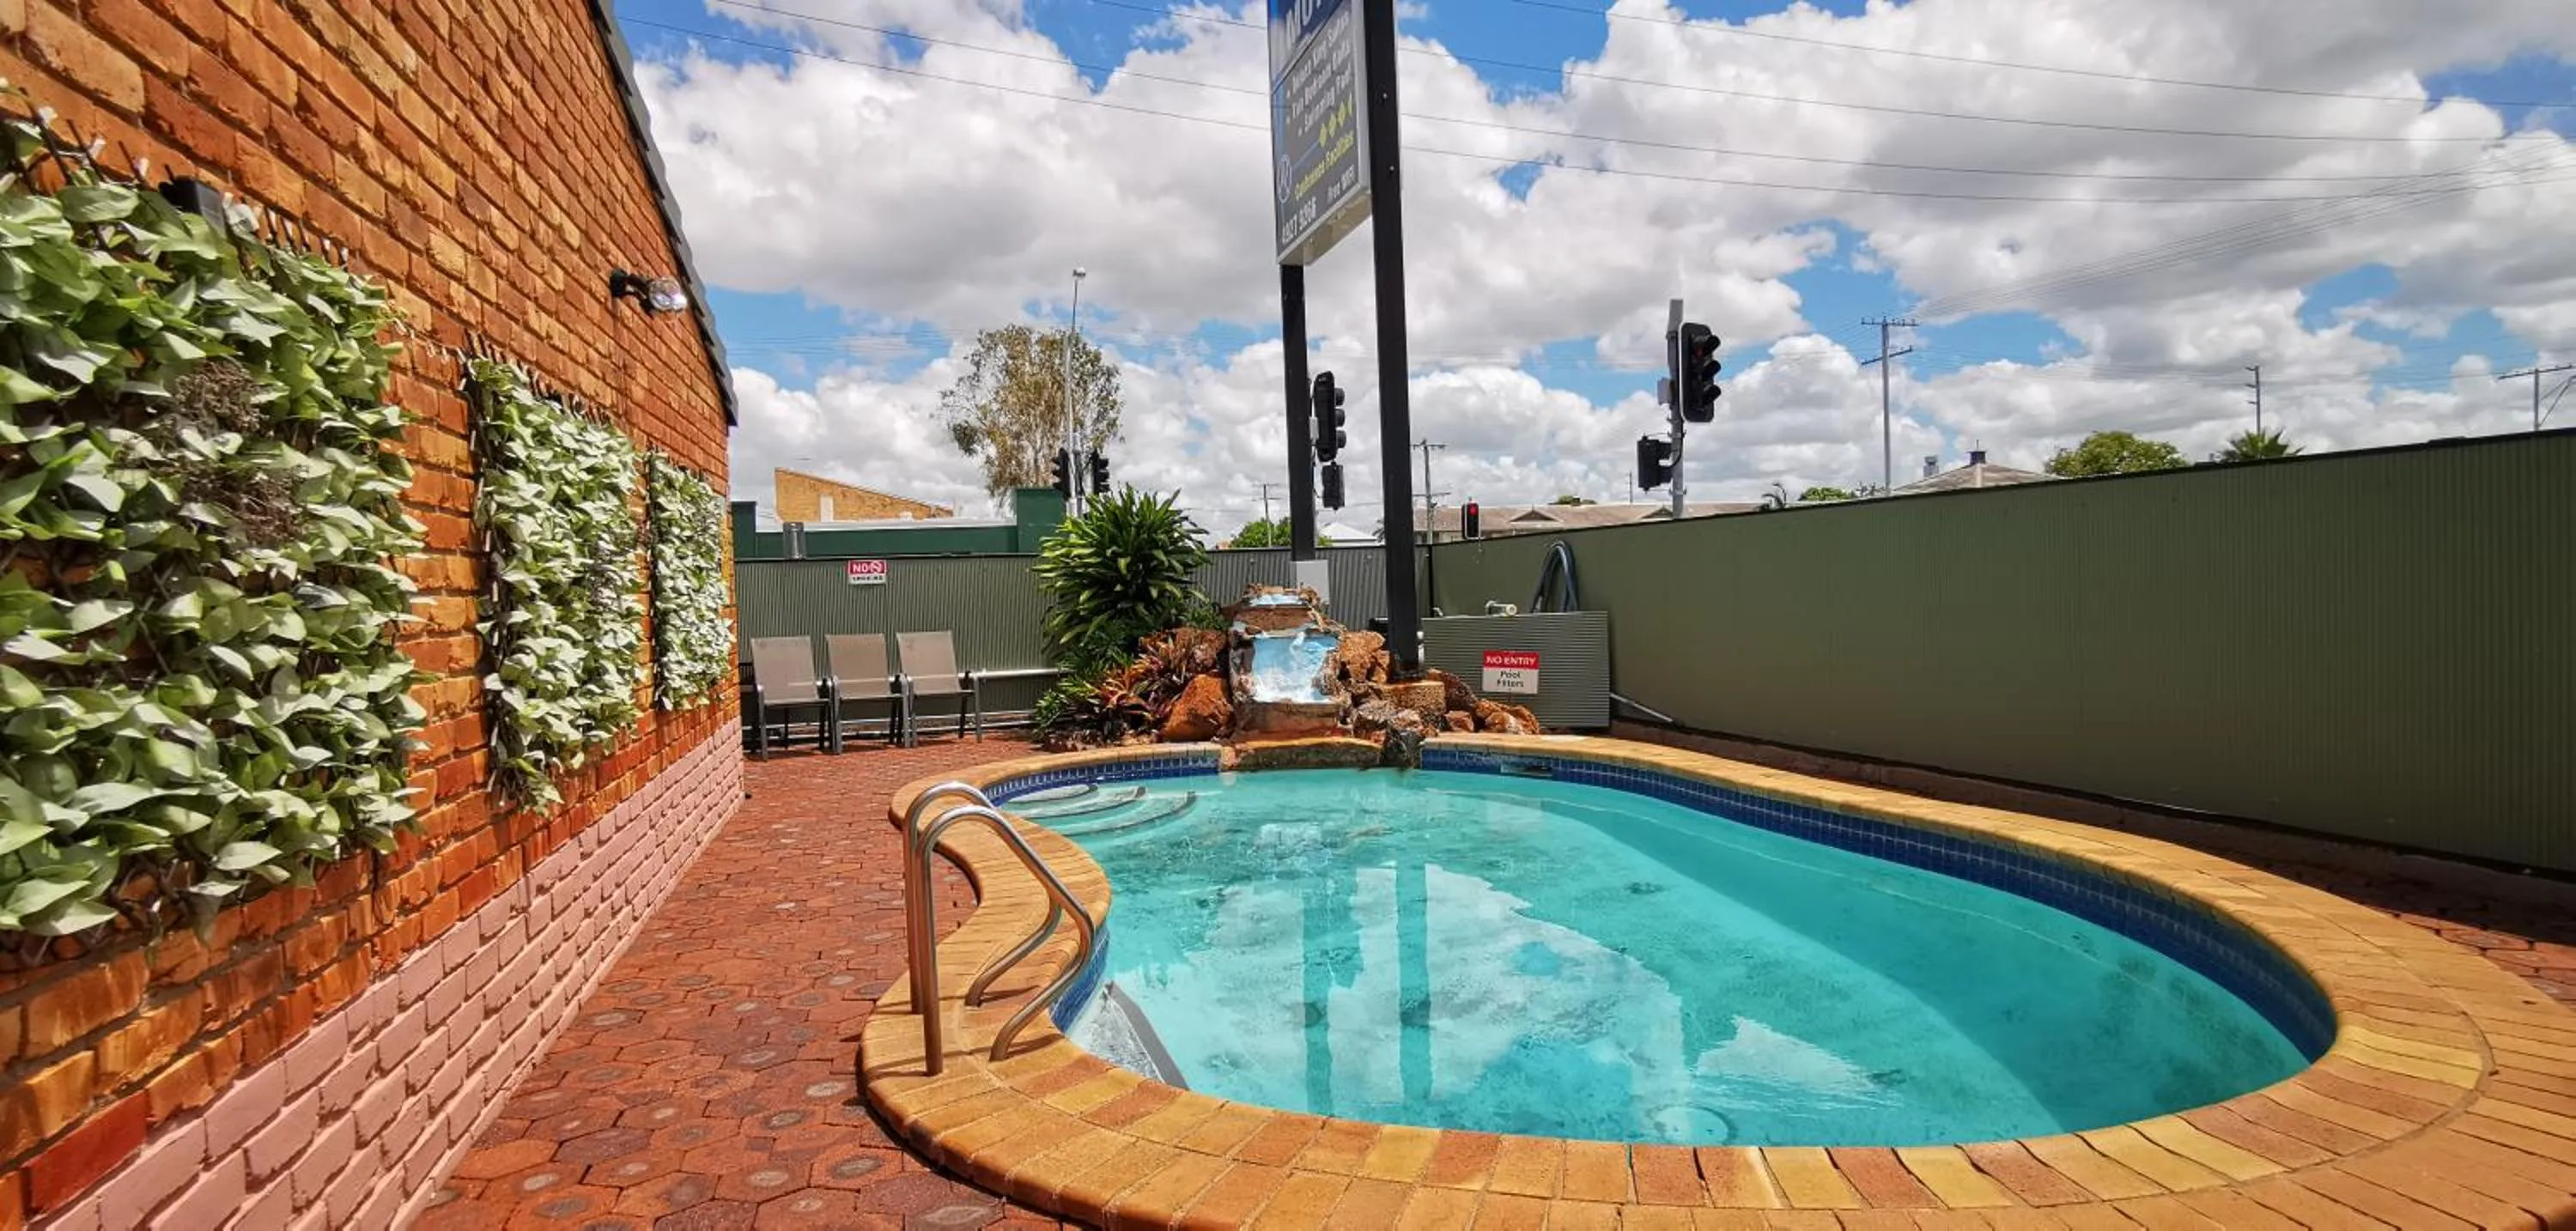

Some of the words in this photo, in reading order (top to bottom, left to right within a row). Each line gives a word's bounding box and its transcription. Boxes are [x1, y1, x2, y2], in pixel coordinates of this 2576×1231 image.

[853, 562, 868, 573] NO
[1485, 655, 1503, 664] NO
[1504, 656, 1536, 665] ENTRY
[1500, 670, 1521, 679] Pool
[1497, 679, 1524, 688] Filters
